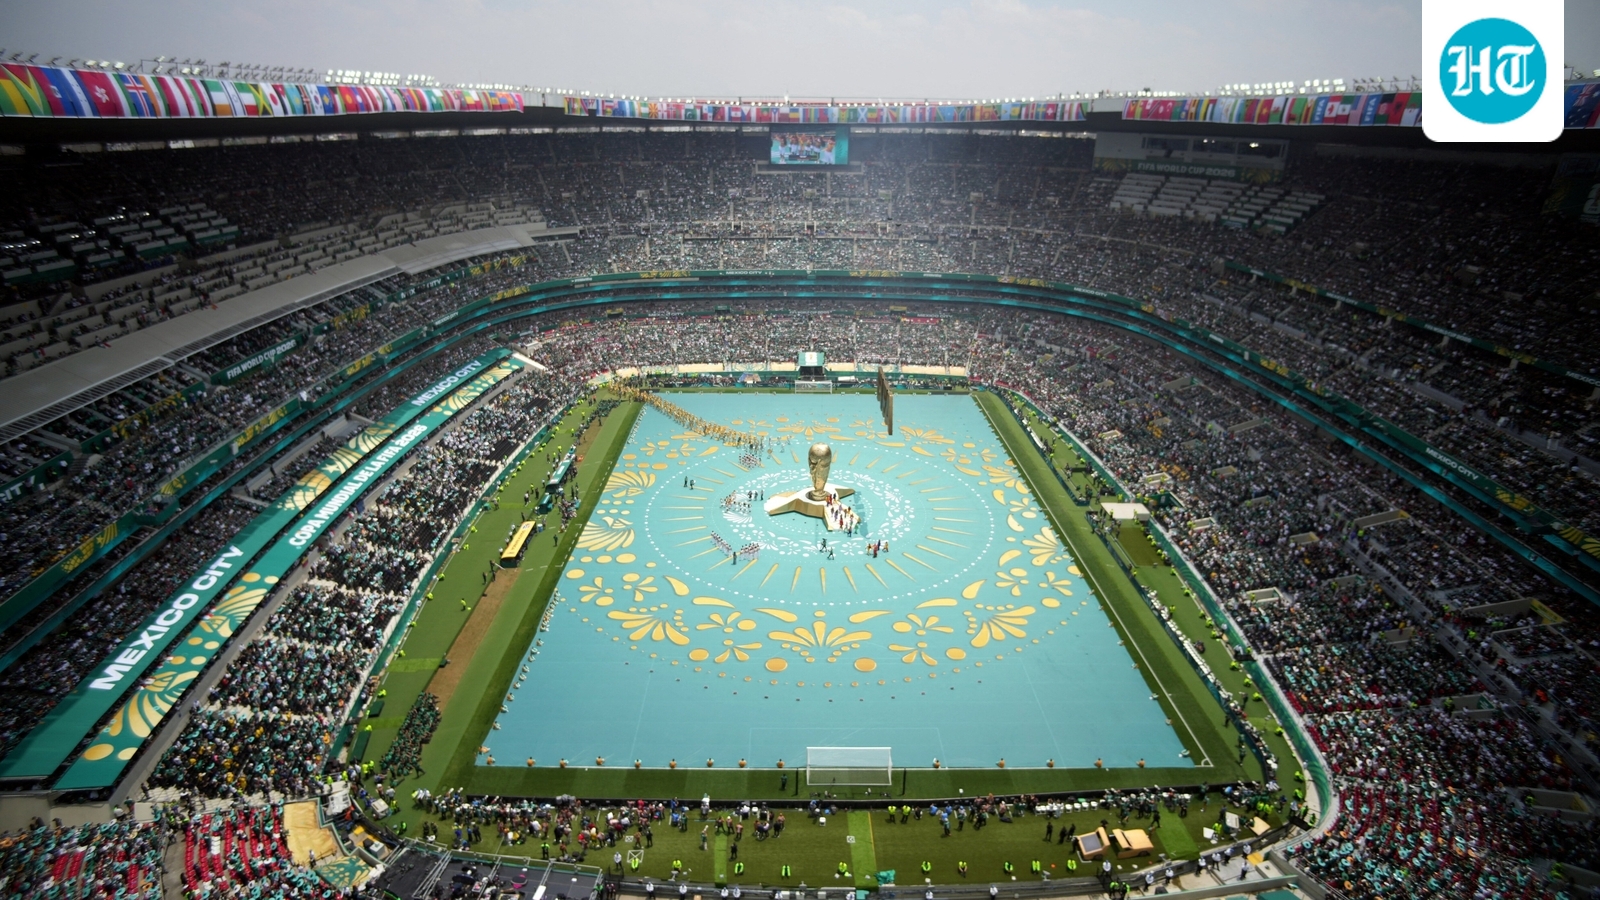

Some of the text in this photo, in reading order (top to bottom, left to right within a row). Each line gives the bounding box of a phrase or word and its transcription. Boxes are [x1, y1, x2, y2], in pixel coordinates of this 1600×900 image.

[1314, 98, 1326, 121] FIFA
[1364, 97, 1377, 121] FIFA
[1138, 162, 1236, 177] FIFA WORLD CUP 2026
[226, 339, 297, 380] FIFA WORLD CUP 2026
[411, 360, 482, 406] MEXICO CITY
[1425, 447, 1479, 480] MEXICO CITY
[288, 424, 428, 547] COPA MUNDIAL DE LA FIFA 2026
[89, 545, 244, 691] MEXICO CITY
